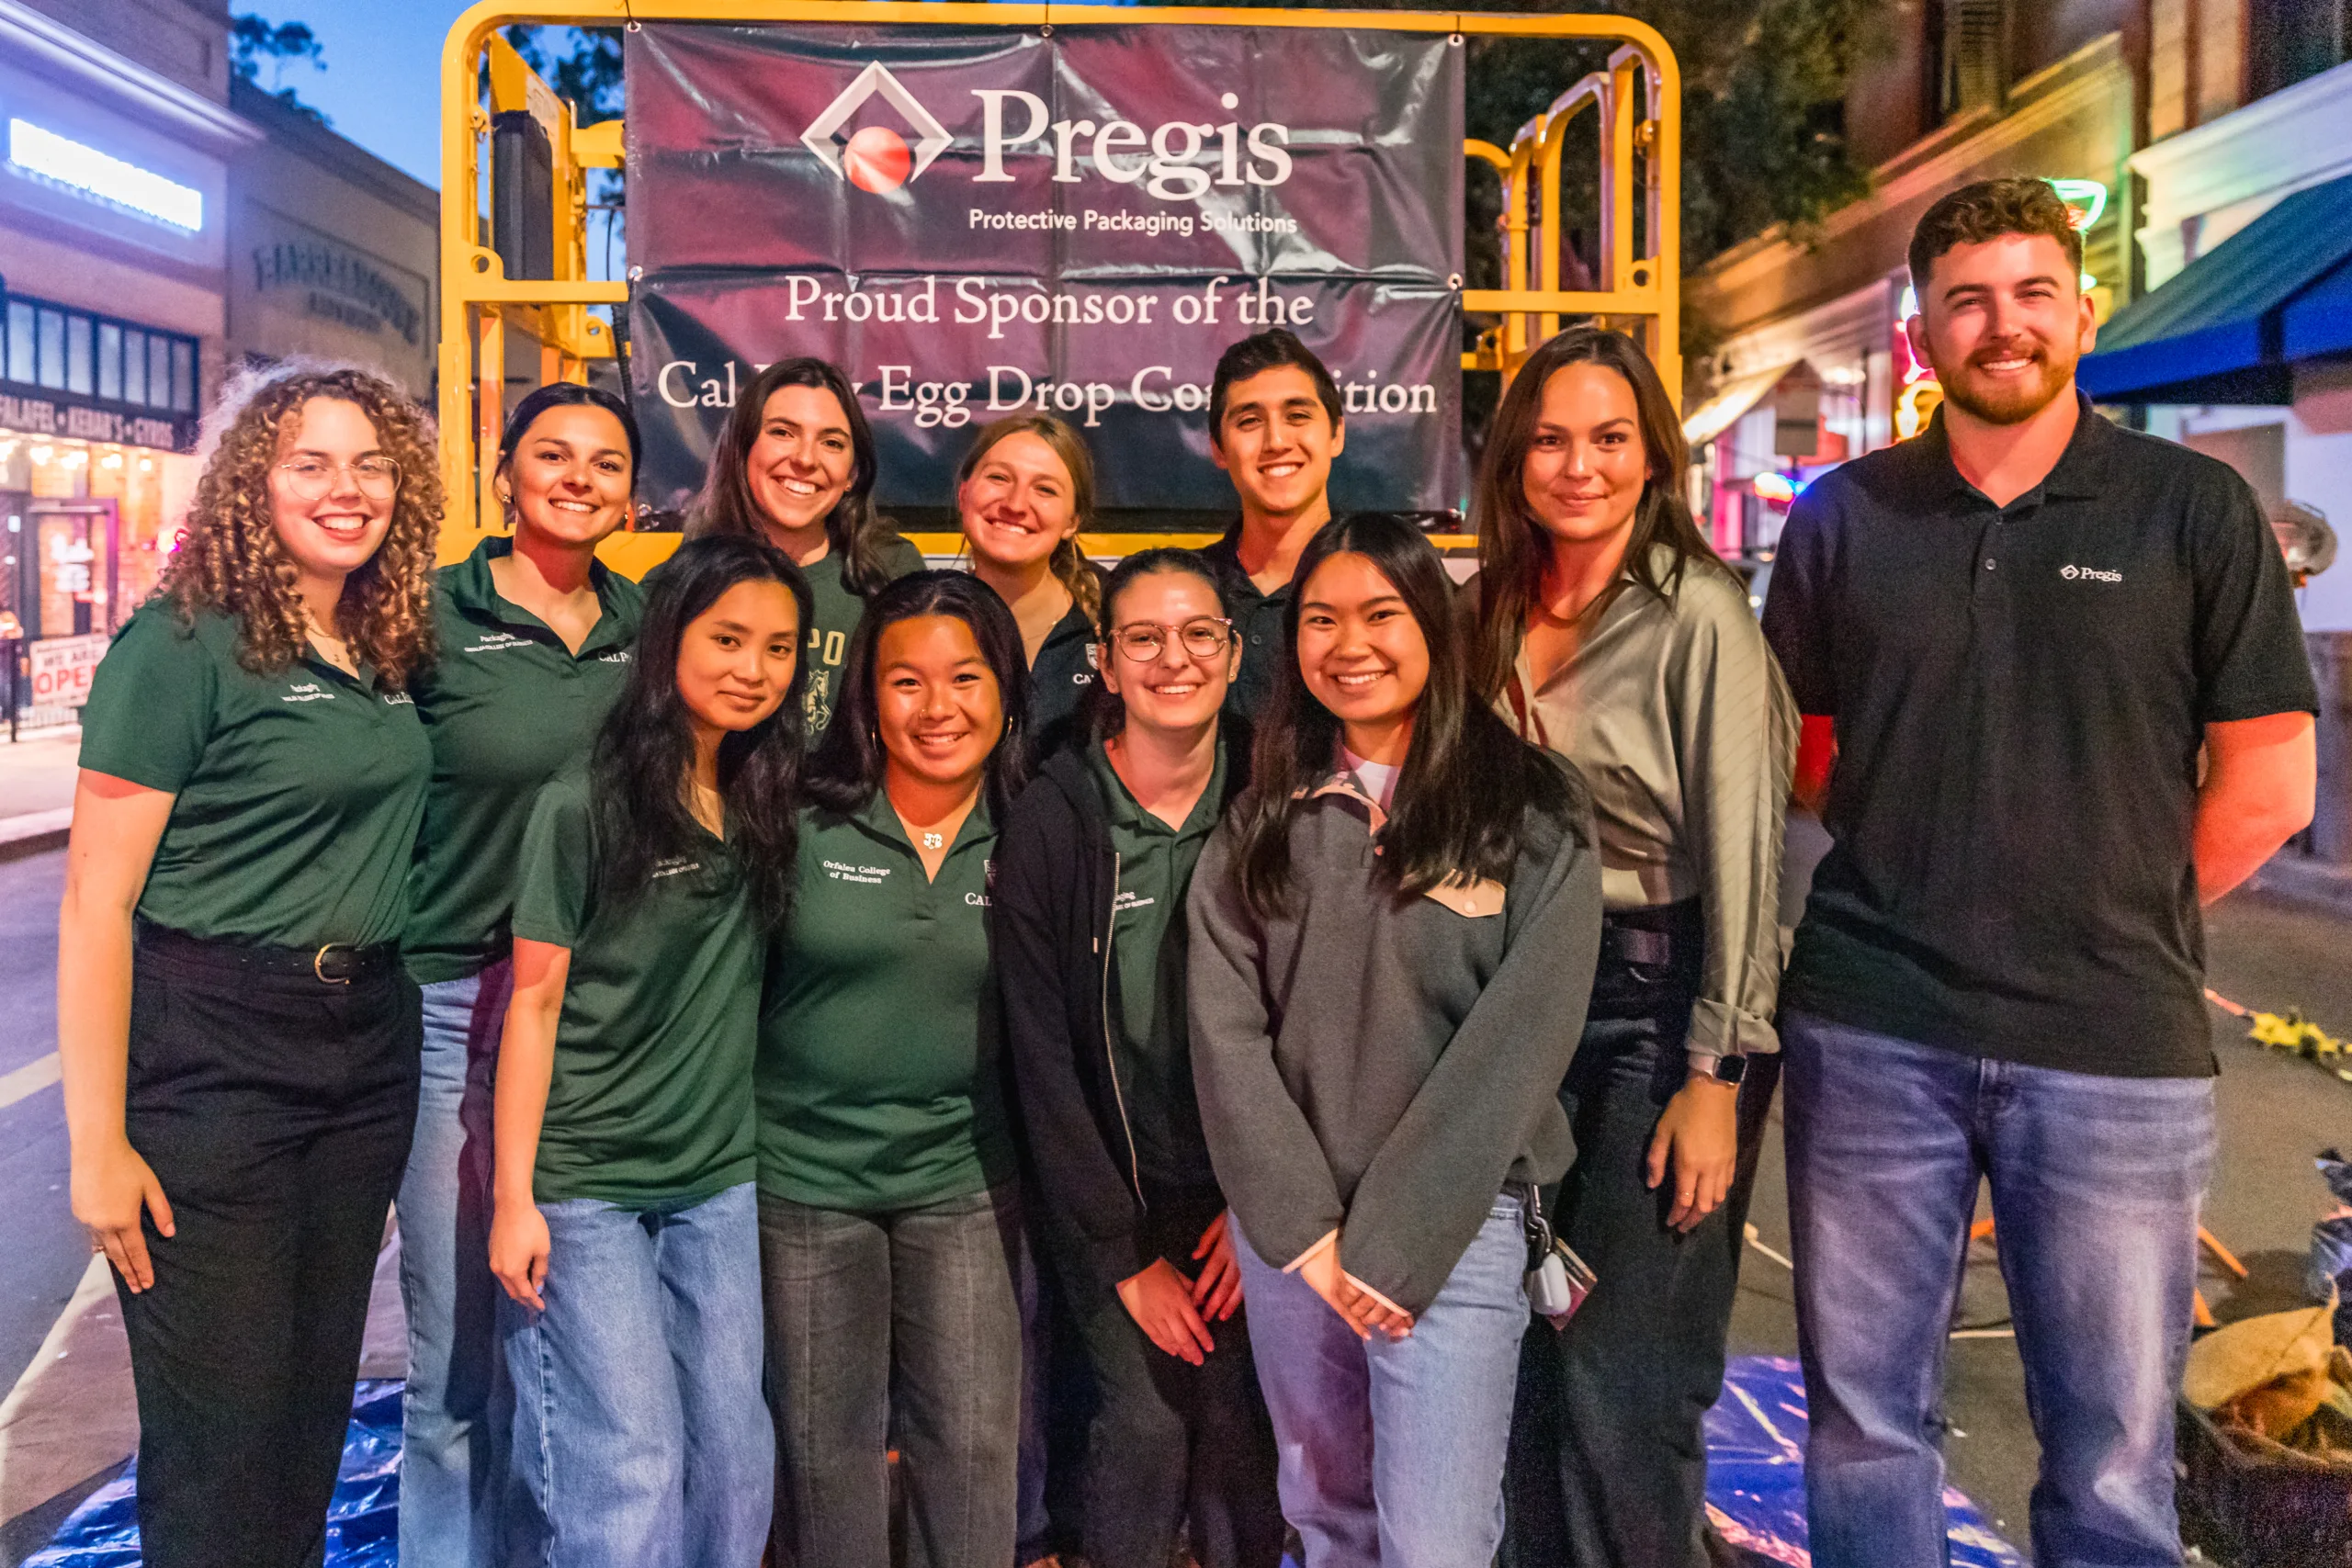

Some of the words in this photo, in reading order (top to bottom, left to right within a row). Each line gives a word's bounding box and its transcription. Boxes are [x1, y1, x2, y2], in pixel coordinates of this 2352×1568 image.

[971, 89, 1293, 201] Pregis
[969, 209, 1077, 231] Protective
[1083, 209, 1193, 237] Packaging
[1200, 210, 1297, 234] Solutions
[785, 275, 940, 323] Proud
[954, 276, 1159, 339] Sponsor
[1172, 275, 1231, 324] of
[1238, 276, 1315, 325] the
[658, 360, 736, 409] Cal
[877, 365, 973, 428] Egg
[986, 365, 1114, 426] Drop
[2080, 567, 2122, 582] Pregis
[823, 860, 855, 873] Orfalea
[858, 865, 890, 876] College
[830, 871, 841, 879] of
[842, 873, 882, 884] Business
